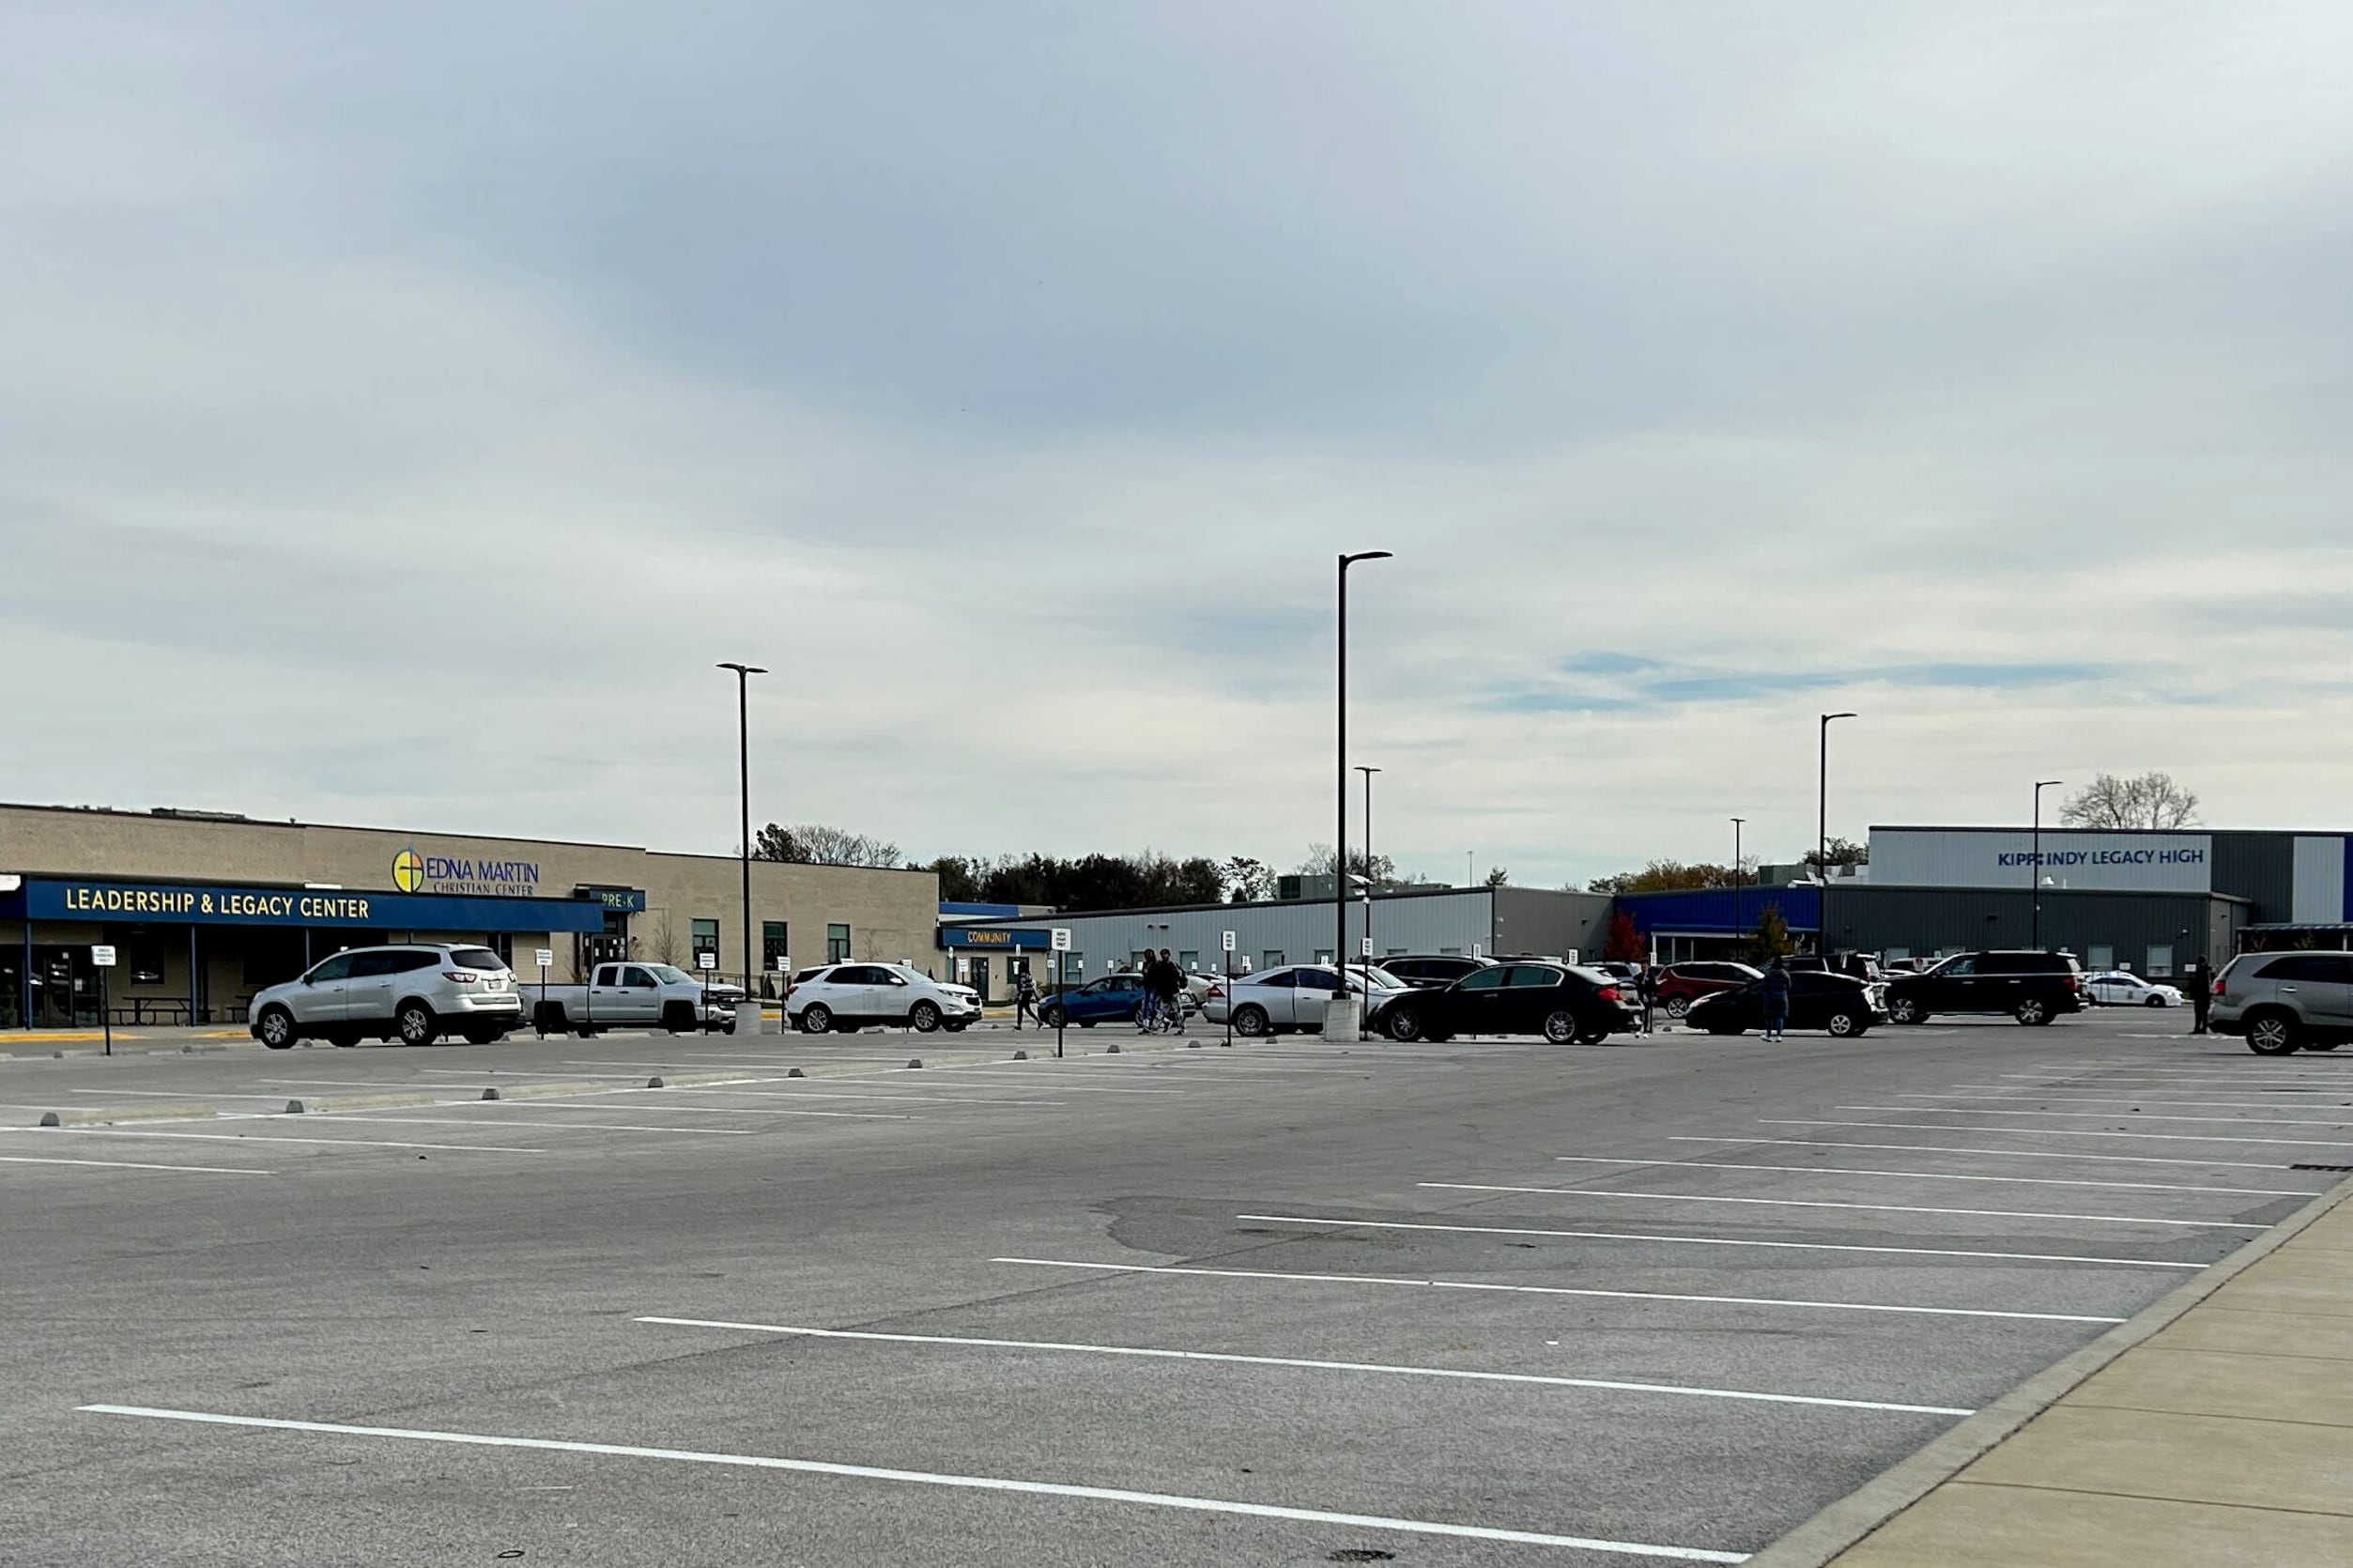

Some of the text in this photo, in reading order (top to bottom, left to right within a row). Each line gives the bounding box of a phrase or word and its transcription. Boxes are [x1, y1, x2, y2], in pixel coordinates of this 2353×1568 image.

[2047, 851, 2087, 866] INDY
[2092, 849, 2154, 865] LEGACY
[2159, 848, 2204, 864] HIGH
[426, 857, 538, 884] EDNA MARTIN
[433, 882, 533, 897] CHRISTIAN CENTER
[66, 888, 369, 919] LEADERSHIP & LEGACY CENTER
